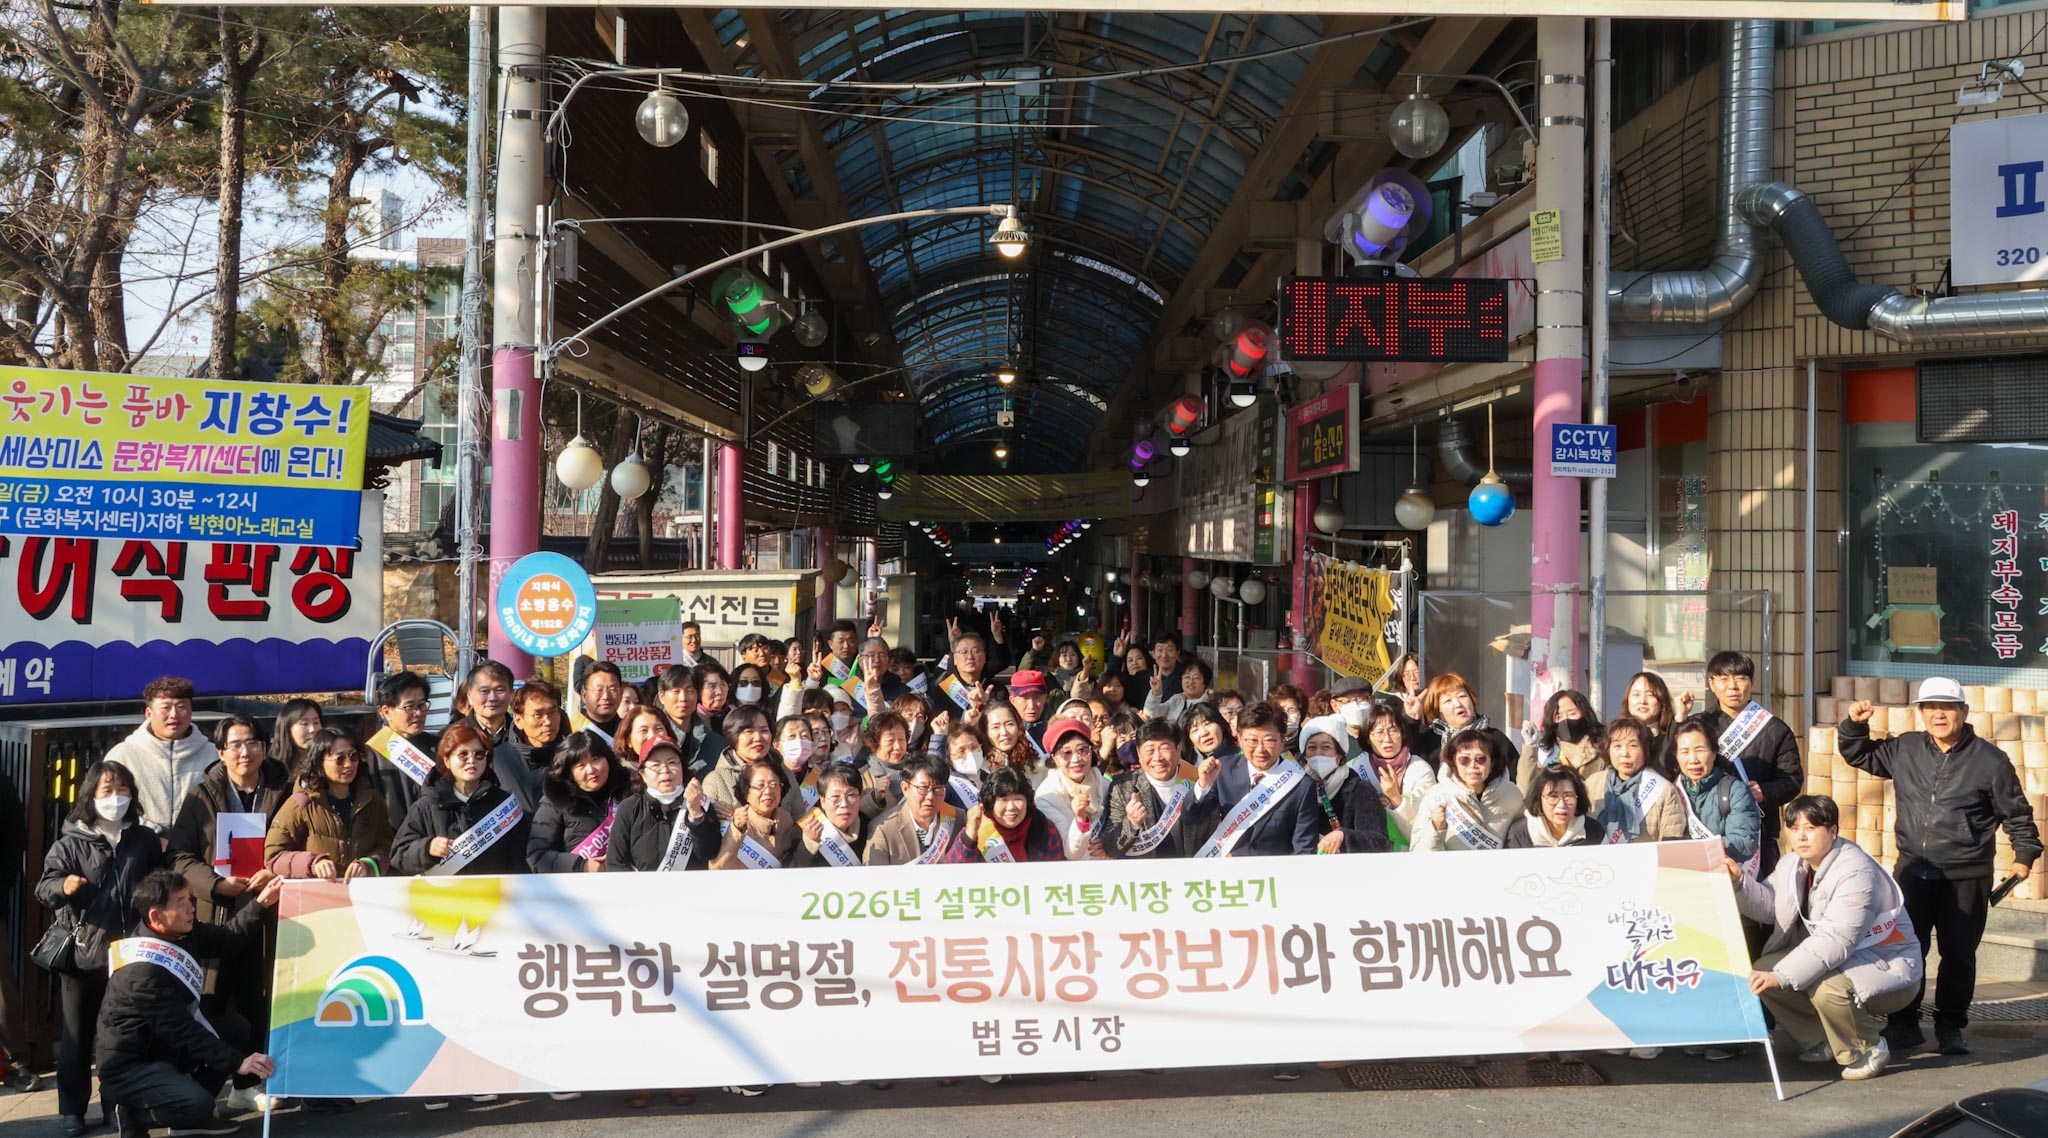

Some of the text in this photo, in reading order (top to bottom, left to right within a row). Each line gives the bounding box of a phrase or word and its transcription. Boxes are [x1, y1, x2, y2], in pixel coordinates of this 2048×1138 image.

[2, 380, 352, 437] 웃기는 품바 지창수!
[1558, 428, 1609, 447] CCTV
[0, 435, 343, 480] 세상미소 문화복지센터에 온다!
[1555, 446, 1612, 463] 감시녹화중
[54, 485, 95, 506] 오전
[101, 486, 145, 509] 10시
[150, 488, 196, 512] 30분
[15, 506, 184, 535] (문화복지센터)지하
[188, 512, 314, 540] 박현아노래교실
[531, 581, 561, 592] 지하식
[1991, 509, 2023, 659] 돼지부속모듬
[520, 598, 574, 612] 소방용수
[531, 619, 564, 629] 제192호
[605, 633, 638, 646] 법동시장
[606, 646, 672, 663] 온누리상품권
[1266, 769, 1293, 796] 소비자의
[474, 816, 498, 838] 안정에
[461, 831, 494, 860] 이용하여
[824, 836, 850, 864] 소비자의
[801, 876, 1278, 922] 2026년 설맞이 전통시장 장보기
[136, 949, 174, 969] 지역물가
[517, 914, 1572, 1019] 행복한 설명절, 전통시장 장보기와 함께해요
[1605, 957, 1701, 992] 대덕구
[972, 1015, 1126, 1057] 법동시장
